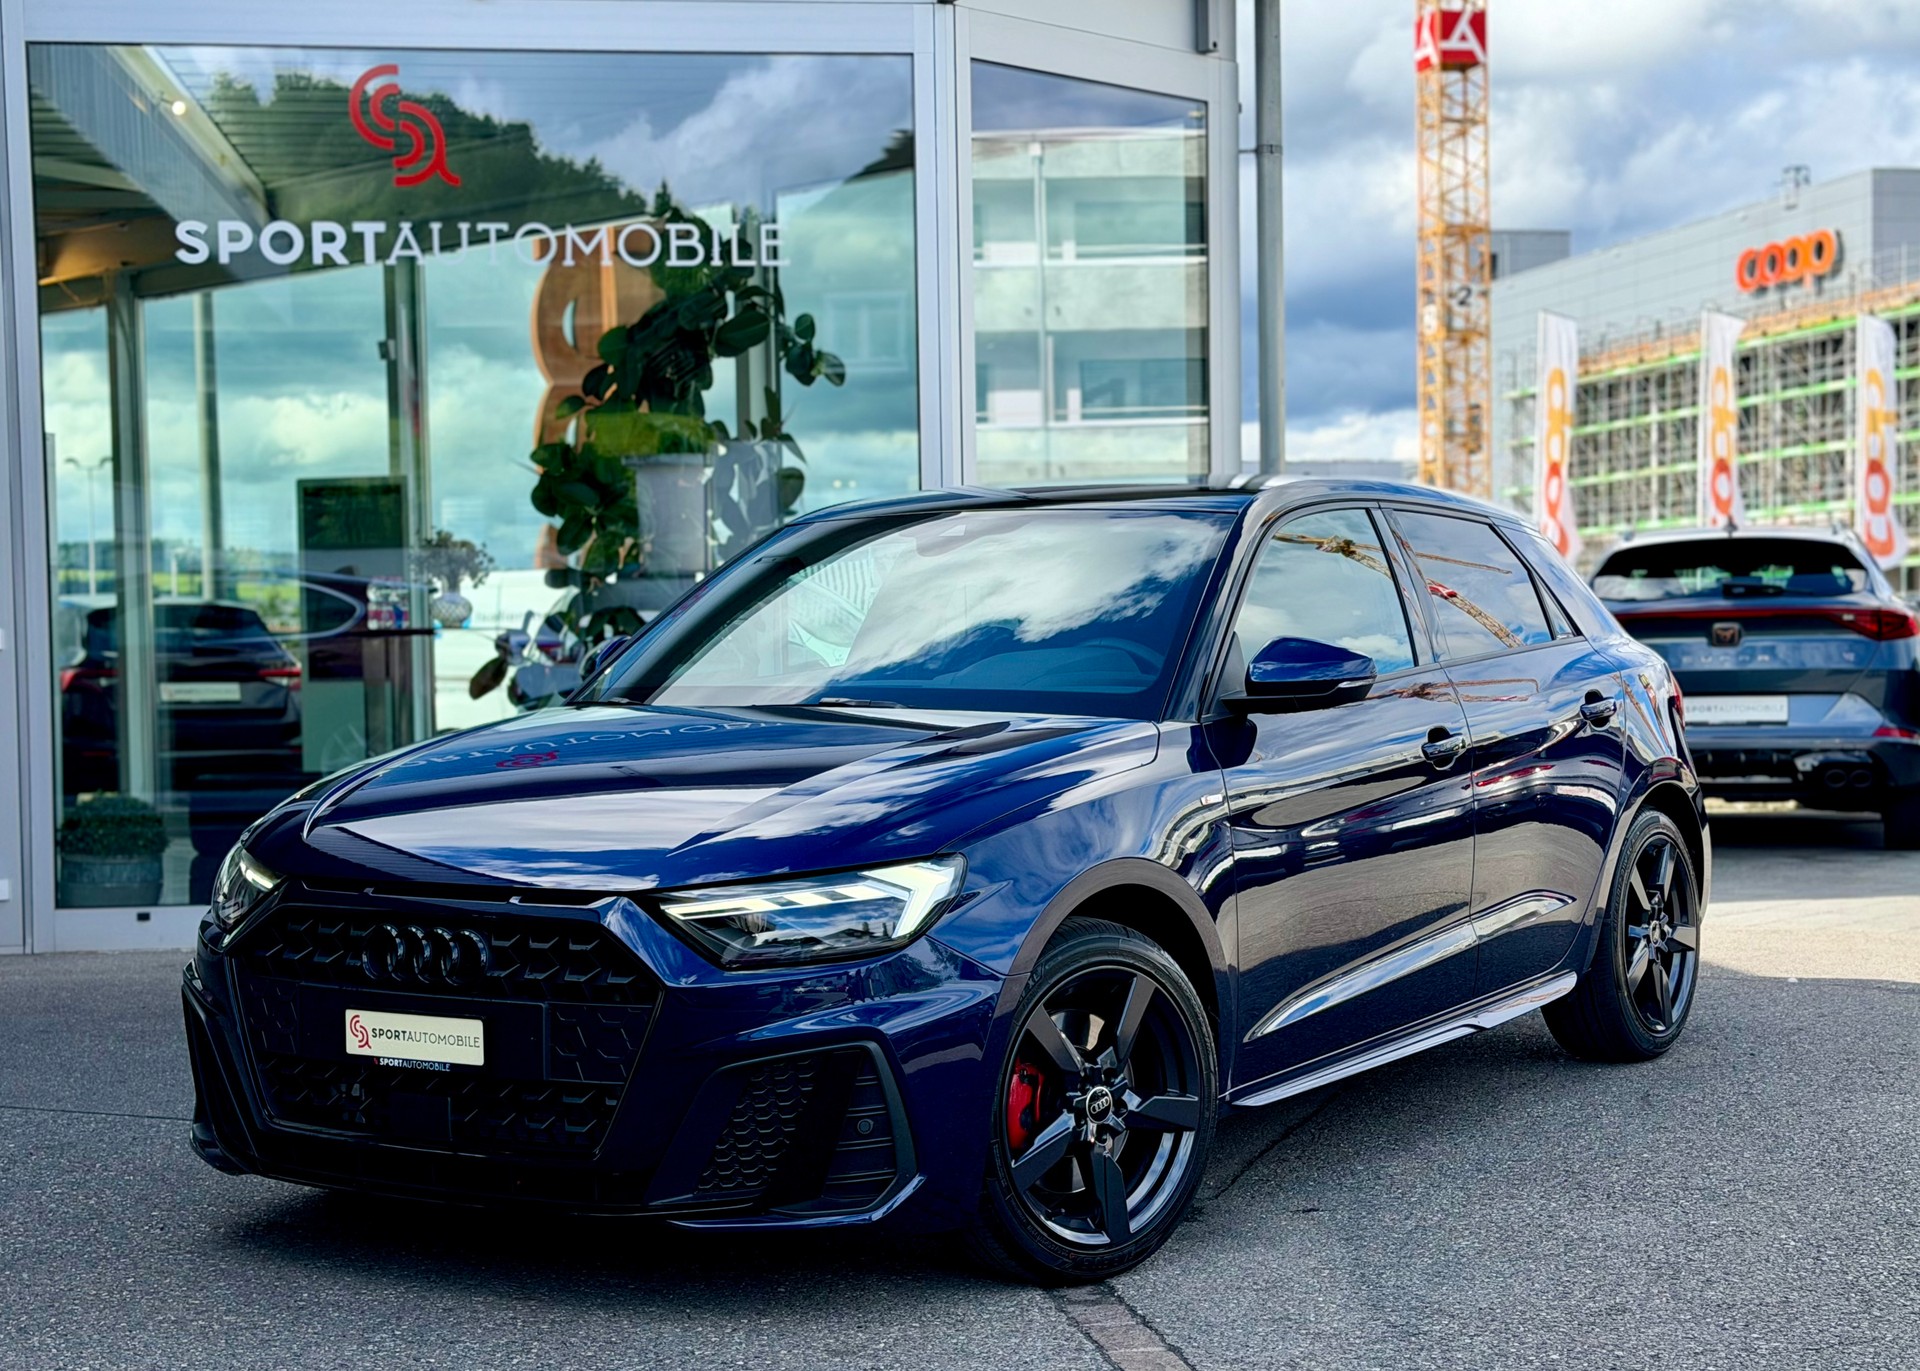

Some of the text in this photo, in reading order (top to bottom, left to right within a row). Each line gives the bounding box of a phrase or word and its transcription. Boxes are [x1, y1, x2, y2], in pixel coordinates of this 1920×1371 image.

[175, 220, 791, 267] SPORTAUTOMOBILE
[1736, 229, 1836, 290] coop
[371, 1028, 480, 1048] SPORTAUTOMOBILE
[379, 1057, 450, 1072] SPORTAUTOMOBILE
